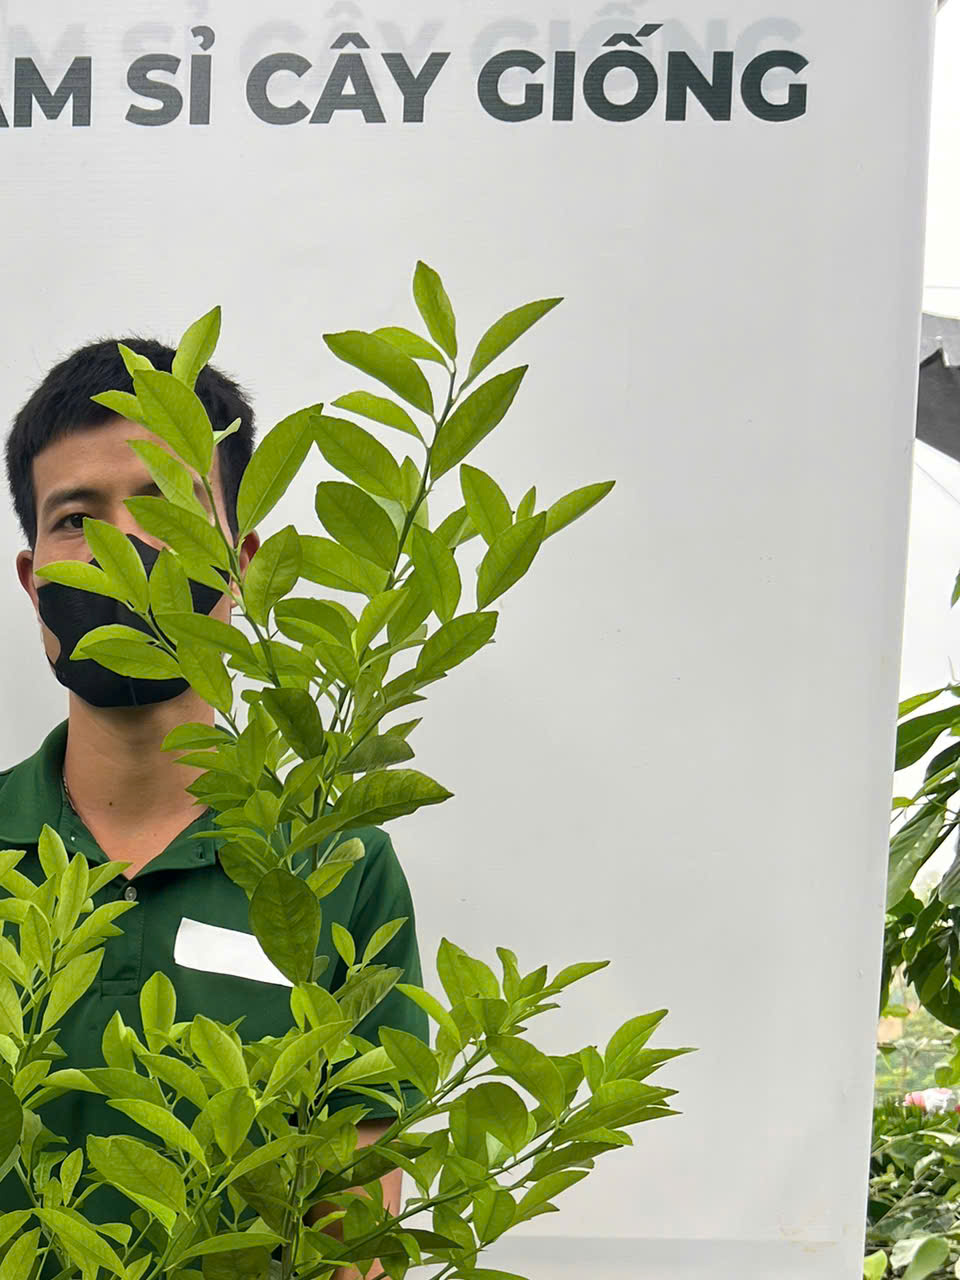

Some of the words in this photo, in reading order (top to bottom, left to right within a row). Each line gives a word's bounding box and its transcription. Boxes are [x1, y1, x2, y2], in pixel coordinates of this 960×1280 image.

[126, 26, 215, 126] SỈ
[247, 33, 450, 125] CÂY
[478, 24, 809, 122] GIỐNG
